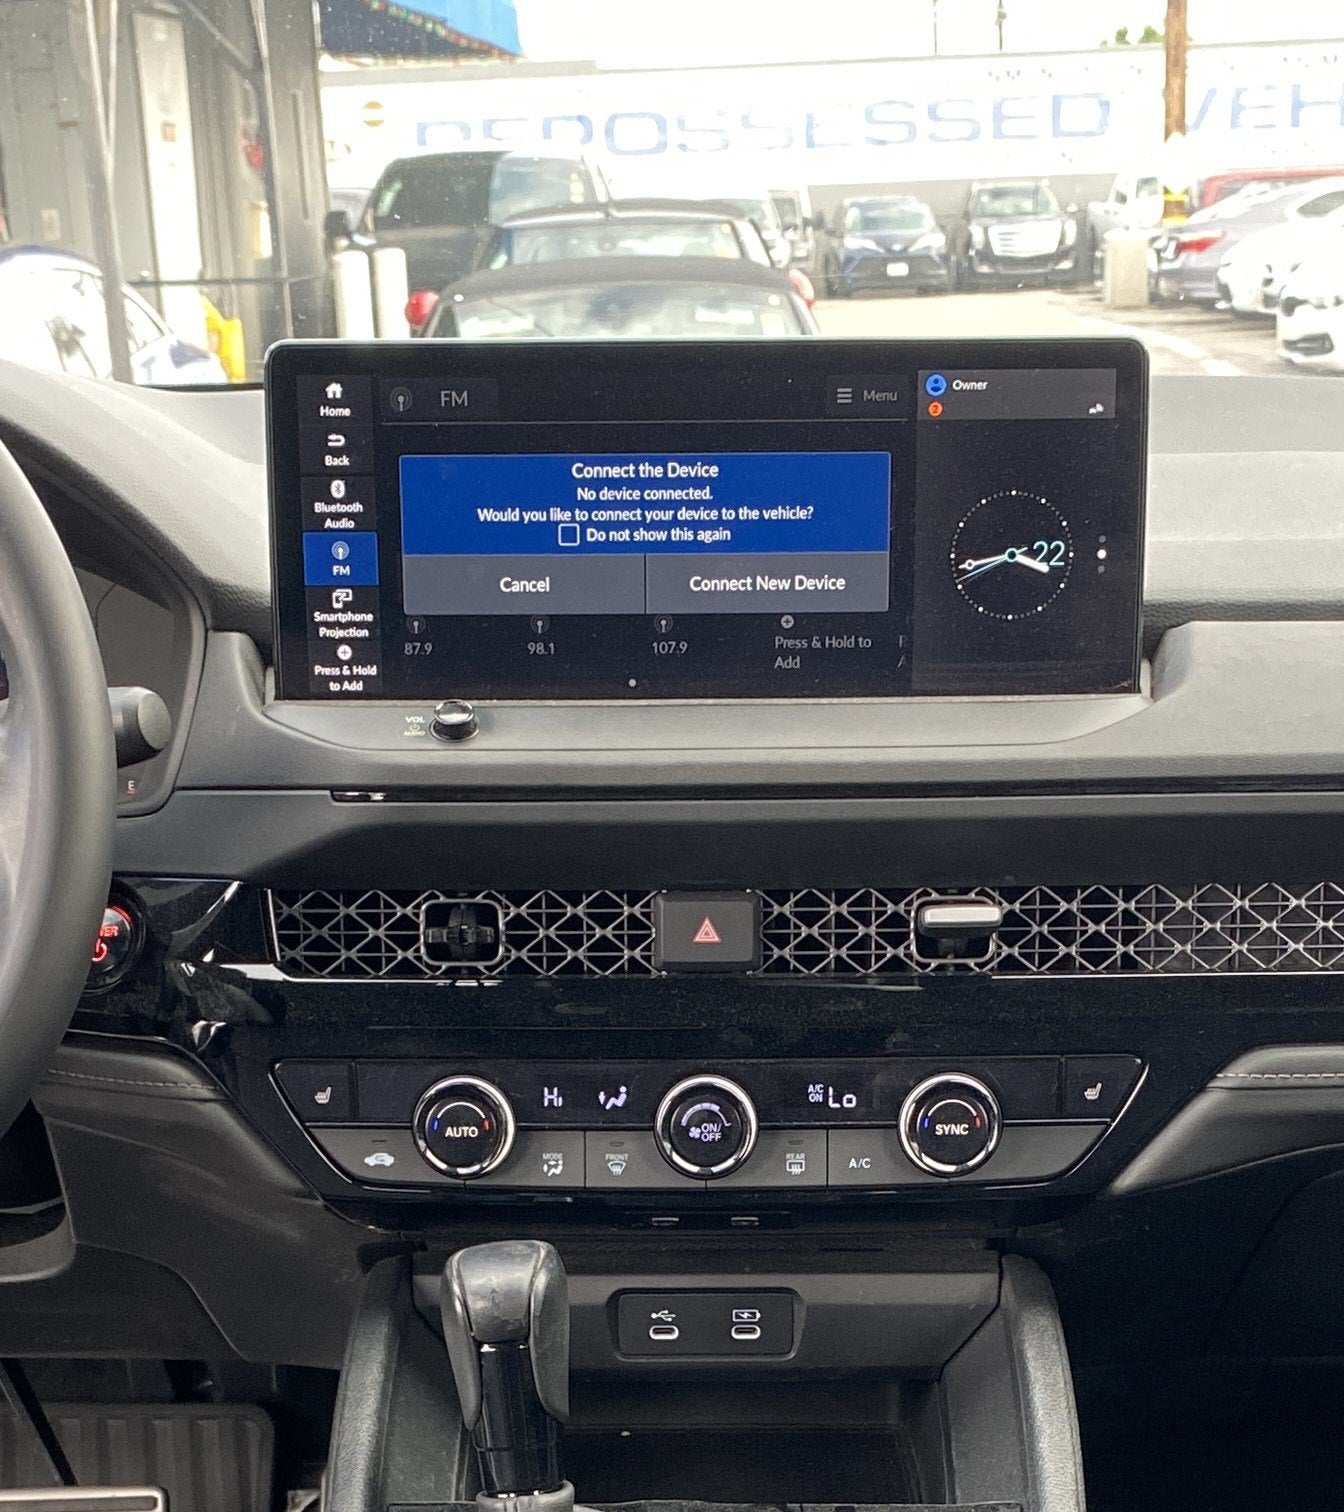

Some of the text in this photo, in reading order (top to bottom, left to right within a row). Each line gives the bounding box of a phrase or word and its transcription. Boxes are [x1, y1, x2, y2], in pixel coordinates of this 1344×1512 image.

[952, 379, 988, 391] Owner
[440, 390, 468, 407] FM
[863, 389, 898, 402] Menu
[319, 405, 351, 417] Home
[324, 455, 350, 466] Back
[571, 461, 719, 479] Connect the Device
[577, 485, 713, 500] No device connected.
[314, 502, 363, 513] Bluetooth
[477, 505, 814, 524] Would you like to connect your device to the vehicle?
[324, 517, 355, 529] Audio
[586, 527, 731, 543] Do not show this again
[332, 565, 351, 576] FM
[499, 576, 550, 592] Cancel
[689, 574, 846, 591] Connect New Device
[313, 611, 374, 624] Smartphone
[318, 627, 369, 640] Projection
[652, 641, 688, 654] 107.9
[774, 635, 872, 649] Press & Hold to
[404, 642, 433, 656] 87.9
[527, 642, 555, 655] 98.1
[774, 656, 801, 669] Add
[314, 665, 377, 676] Press & Hold
[329, 680, 363, 691] to Add
[405, 716, 426, 724] VOL
[808, 1084, 824, 1094] A/C
[808, 1093, 823, 1103] ON
[828, 1087, 856, 1108] Lo
[445, 1127, 479, 1138] AUTO
[935, 1124, 969, 1136] SYNC
[701, 1133, 721, 1142] OFF
[543, 1153, 563, 1161] MODE
[606, 1153, 628, 1161] FRONT
[786, 1153, 805, 1161] REAR
[849, 1158, 871, 1169] A/C
